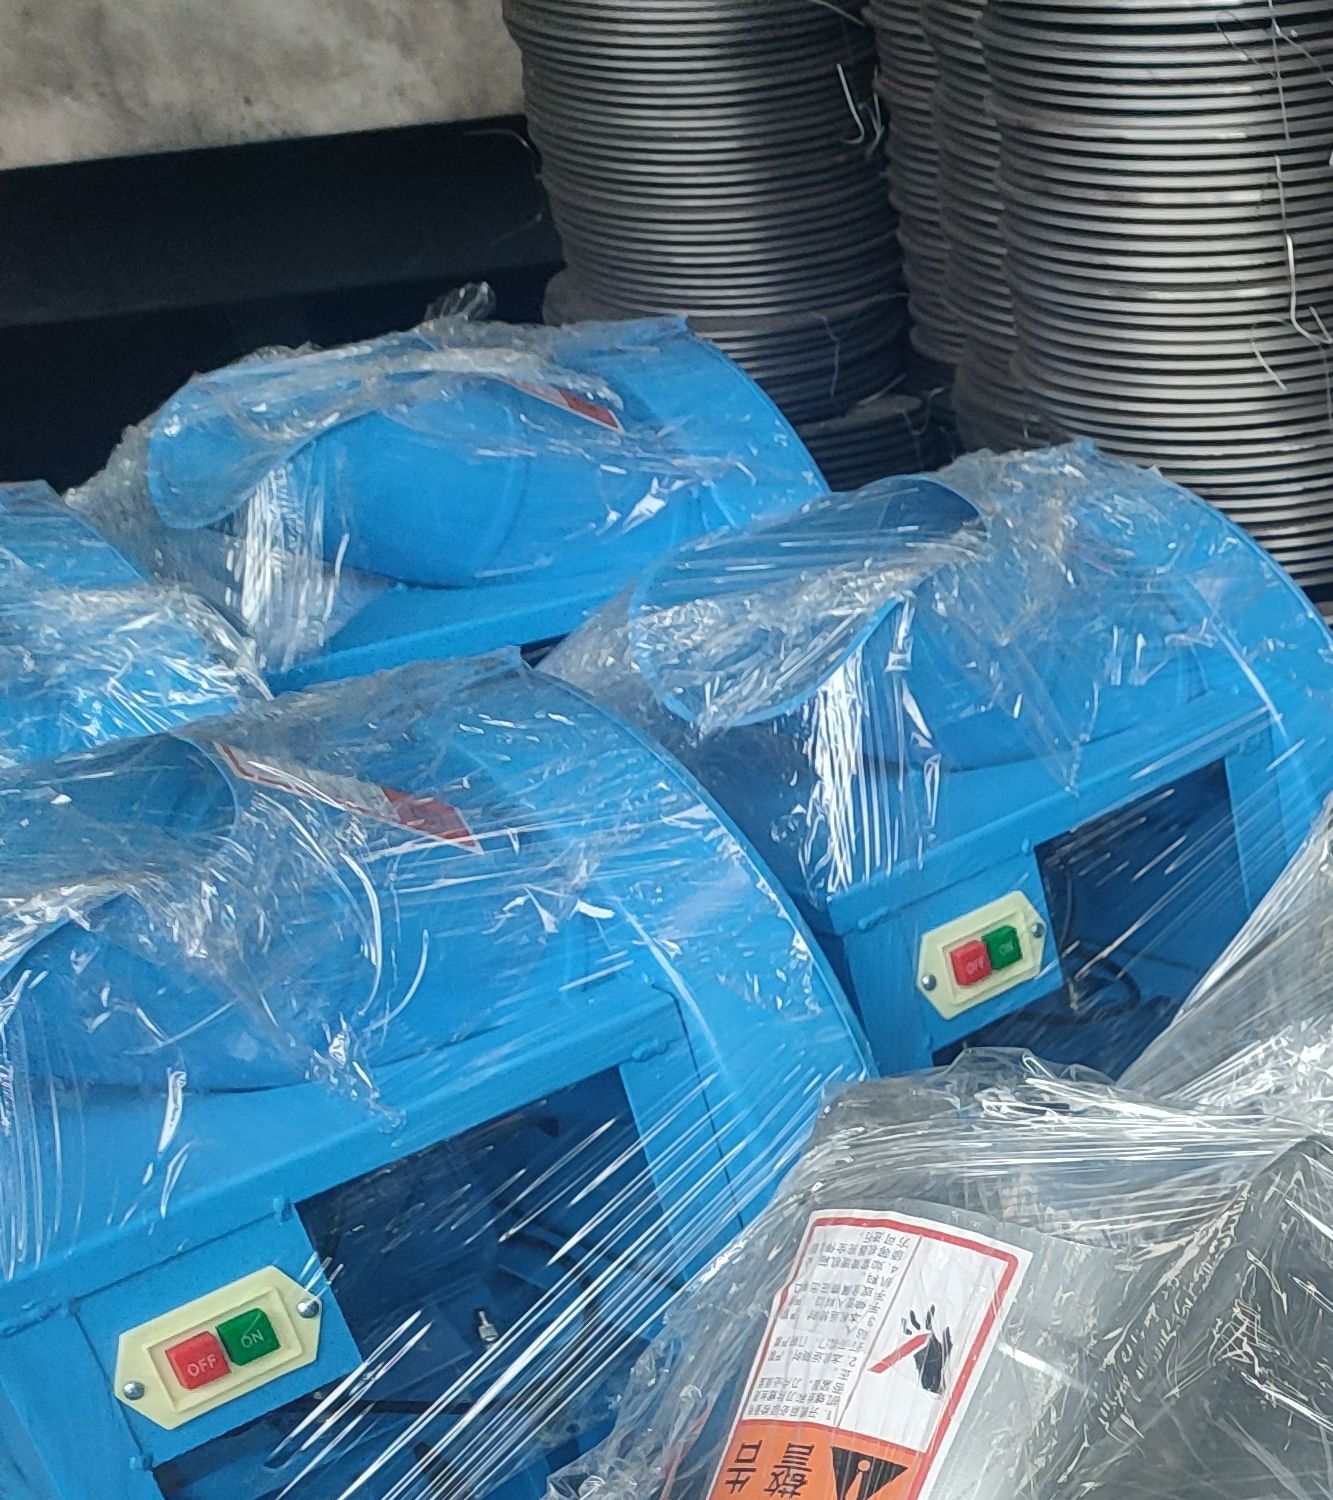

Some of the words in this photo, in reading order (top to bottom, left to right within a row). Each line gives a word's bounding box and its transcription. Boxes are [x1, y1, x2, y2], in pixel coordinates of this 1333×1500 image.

[187, 1353, 218, 1377] OFF
[240, 1330, 265, 1349] ON
[724, 1440, 815, 1499] 警告
